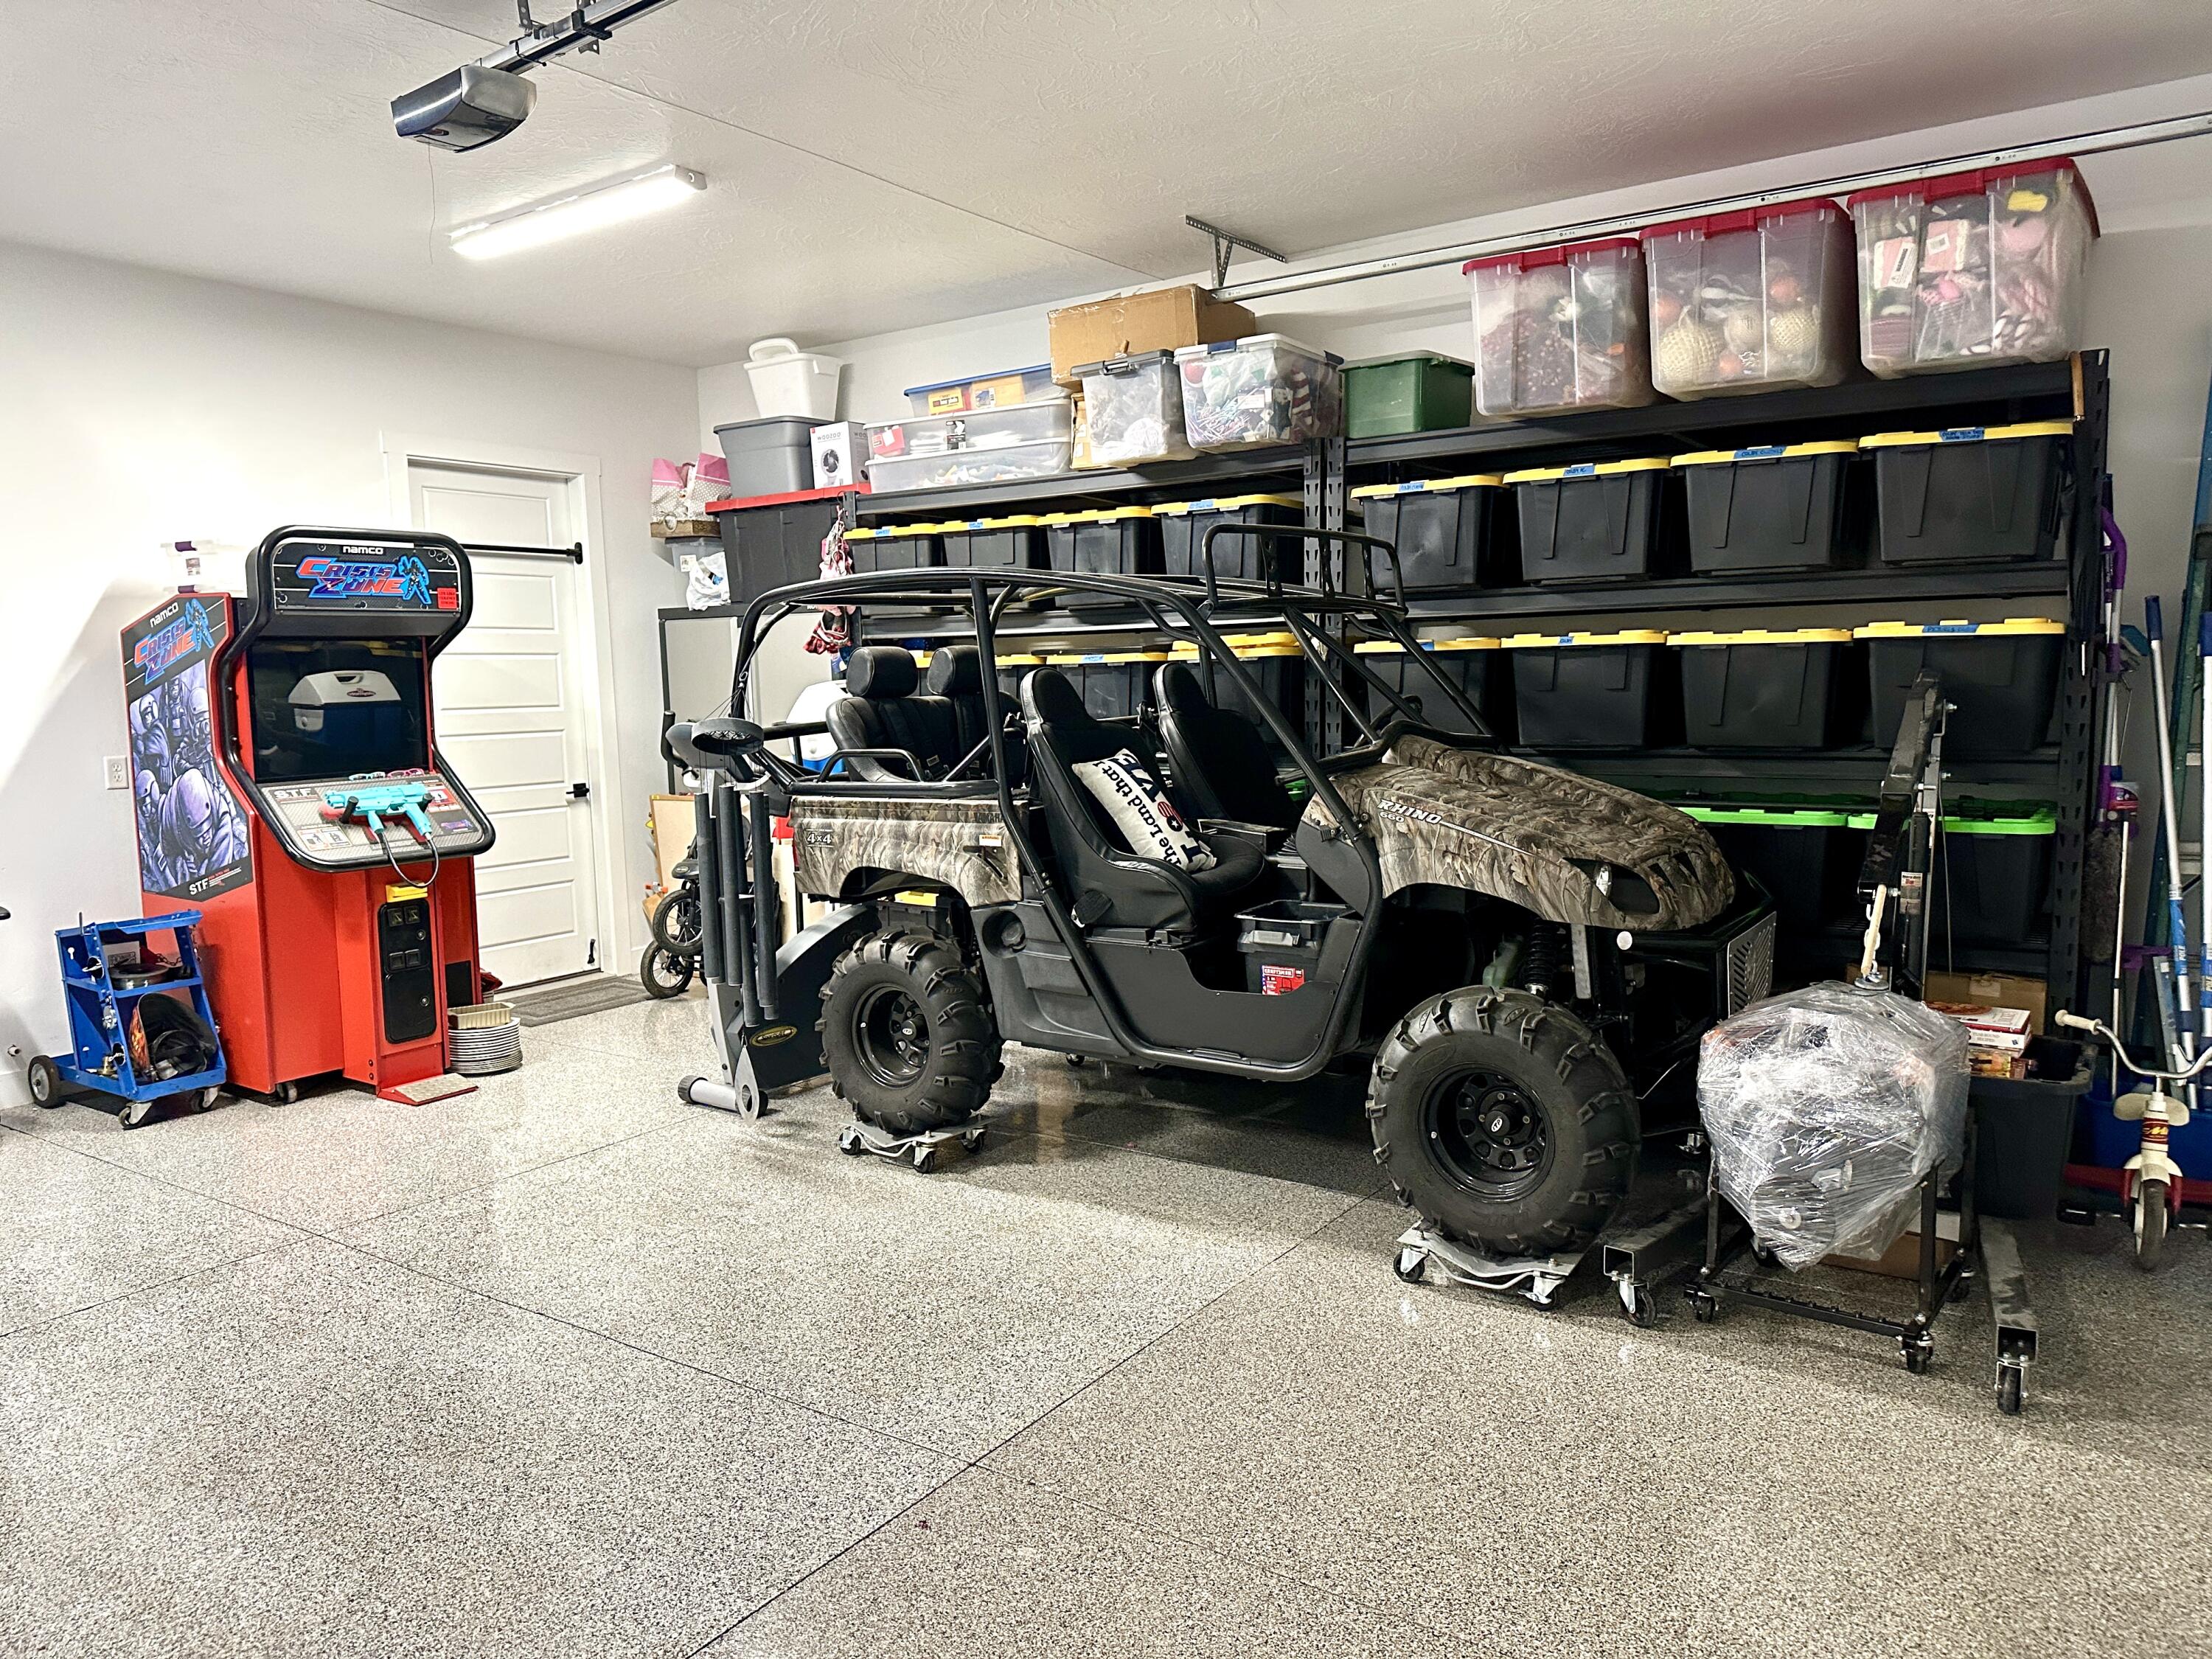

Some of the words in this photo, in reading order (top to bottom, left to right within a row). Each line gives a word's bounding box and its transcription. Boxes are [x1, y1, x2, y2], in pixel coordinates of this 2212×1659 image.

[342, 546, 384, 555] namco
[297, 557, 395, 579] CRISIS
[310, 576, 405, 596] ZONE
[150, 602, 179, 628] namco
[134, 616, 186, 665] CRISIS
[145, 629, 197, 682] ZONE
[1101, 765, 1134, 798] that
[1127, 794, 1164, 838] Land
[1377, 799, 1443, 824] RHINO
[1380, 811, 1405, 823] 660
[807, 832, 832, 844] 4x4
